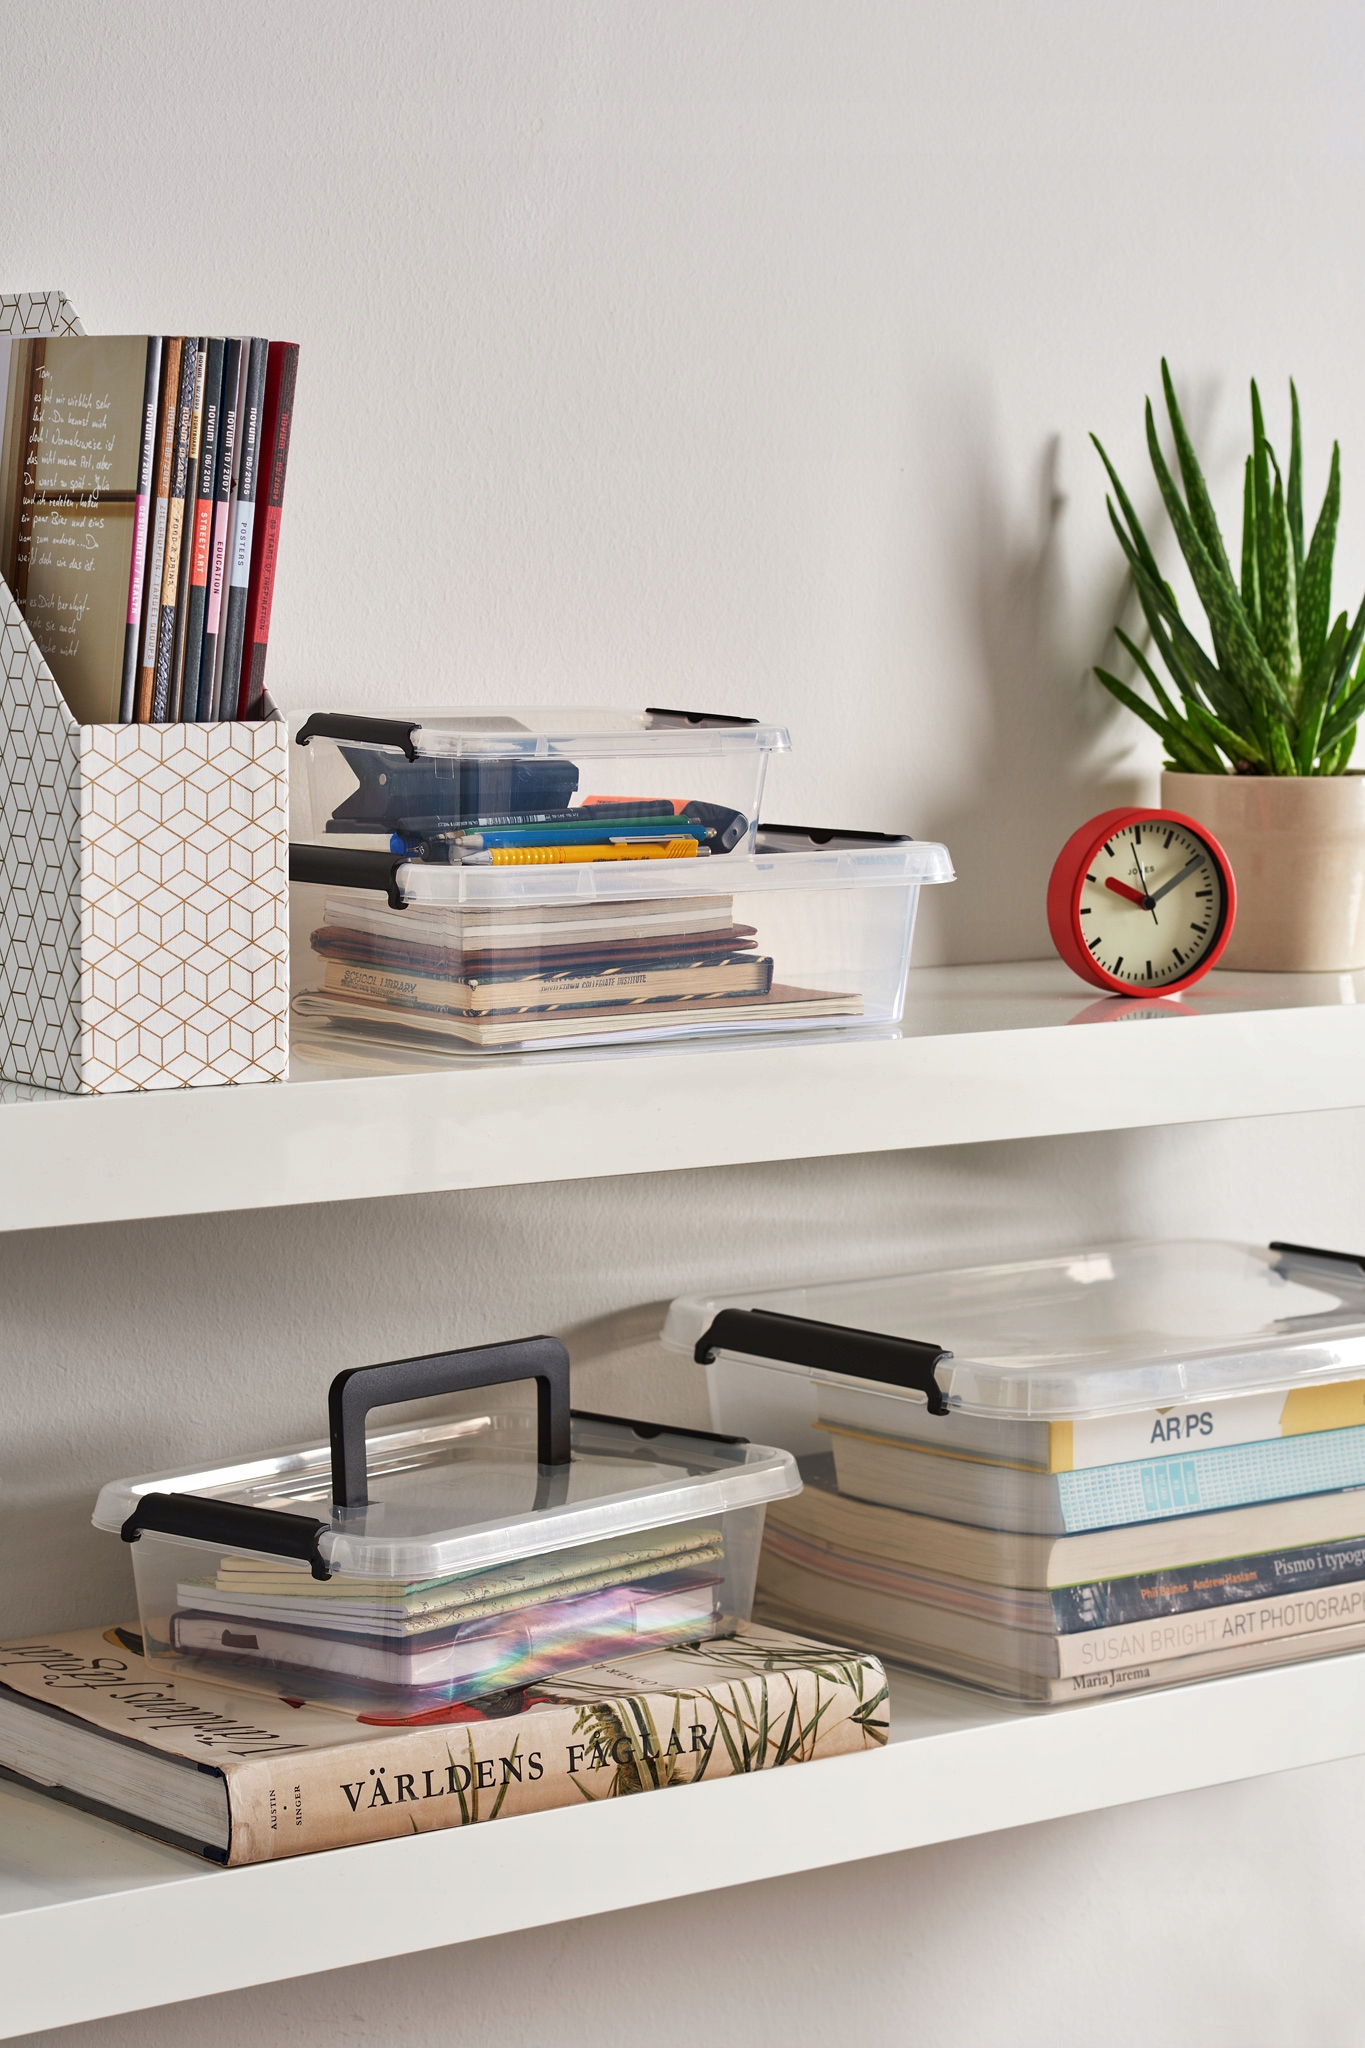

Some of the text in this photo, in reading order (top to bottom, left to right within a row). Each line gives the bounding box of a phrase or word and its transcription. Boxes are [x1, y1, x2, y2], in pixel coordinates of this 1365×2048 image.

[145, 404, 154, 440] novum
[166, 406, 175, 443] novum
[206, 404, 216, 442] novum
[248, 407, 257, 444] novum
[278, 413, 288, 450] novum
[222, 410, 235, 493] novum 10/2007
[202, 455, 212, 494] 06/2005
[134, 505, 146, 565] GESUNDHEIT
[196, 512, 208, 573] STREET ART
[238, 522, 247, 566] POSTERS
[266, 533, 275, 560] YEARS
[213, 541, 223, 595] EDUCATION
[265, 563, 272, 574] OF
[131, 576, 142, 614] HEALTH
[259, 577, 270, 631] INSPIRATION
[1127, 865, 1155, 876] JOES
[344, 969, 376, 986] SCHOOL
[379, 977, 417, 994] LIBRARY
[1140, 1588, 1158, 1600] Phil
[1159, 1582, 1189, 1597] Baines
[1193, 1576, 1224, 1591] Andrew
[1273, 1556, 1315, 1576] Pismo
[1317, 1552, 1323, 1568] i
[1081, 1592, 1365, 1664] SUSAN BRIGHT ART PHOTOGRAP
[1072, 1669, 1150, 1690] Maria Jarema
[340, 1723, 713, 1812] VÄRLDENS FÅGLAR
[269, 1789, 278, 1830] AUSTIN
[294, 1785, 302, 1826] SINGER
